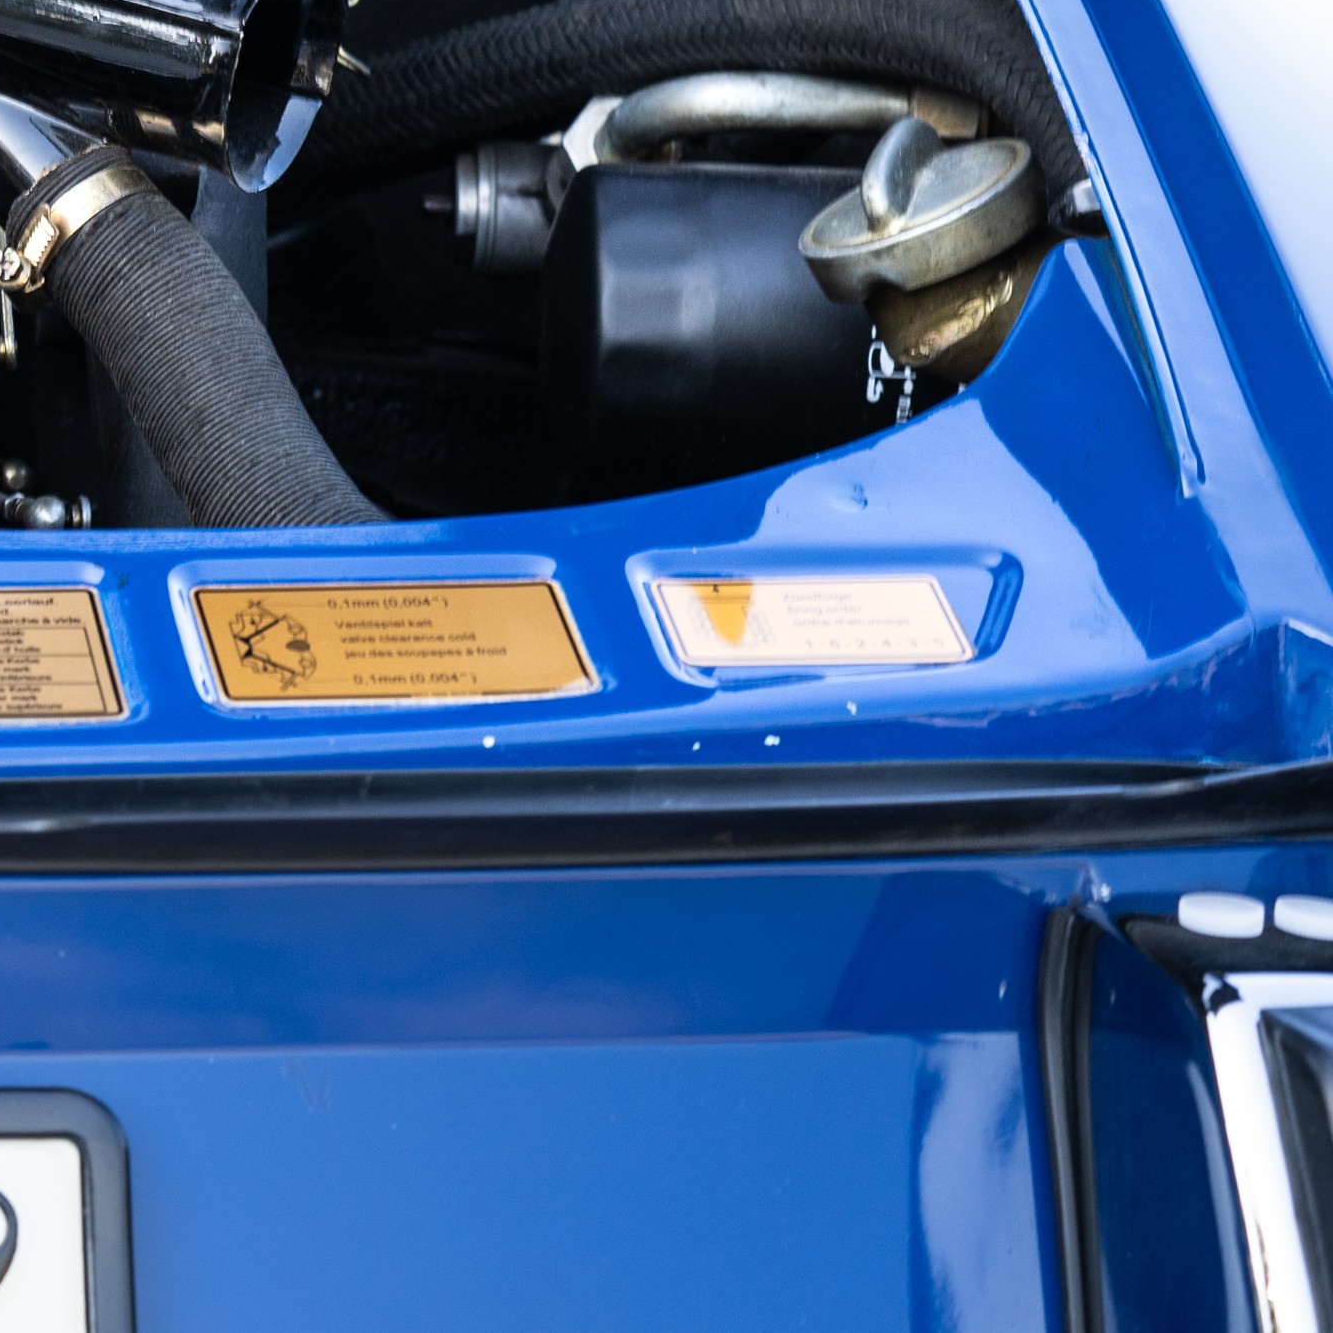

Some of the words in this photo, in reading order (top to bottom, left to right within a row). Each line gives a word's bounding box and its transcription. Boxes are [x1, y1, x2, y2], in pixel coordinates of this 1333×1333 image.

[334, 619, 405, 630] Ventilspiel
[407, 618, 432, 628] kalt
[340, 634, 375, 643] valve
[379, 633, 444, 643] clearance
[448, 632, 476, 642] cold
